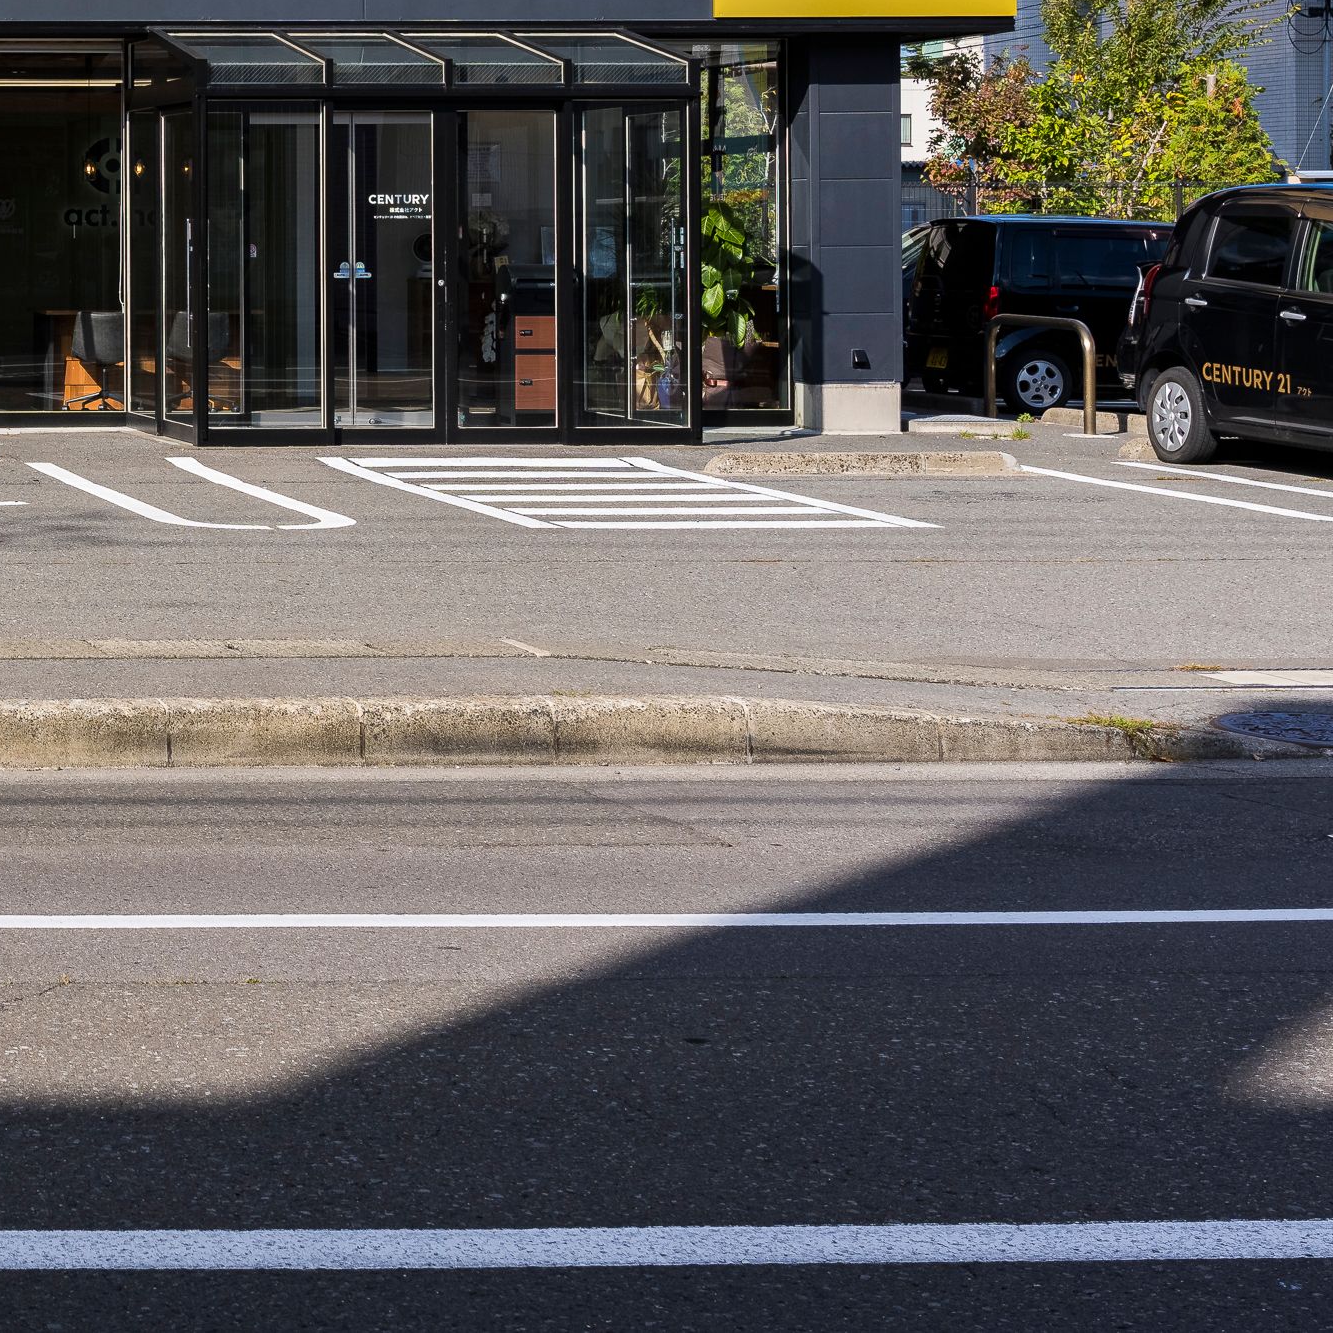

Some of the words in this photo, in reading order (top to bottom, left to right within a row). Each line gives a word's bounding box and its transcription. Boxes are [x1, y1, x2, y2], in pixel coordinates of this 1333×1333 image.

[368, 194, 430, 205] CENTURY
[1202, 362, 1274, 391] CENTURY
[1277, 373, 1291, 394] 21
